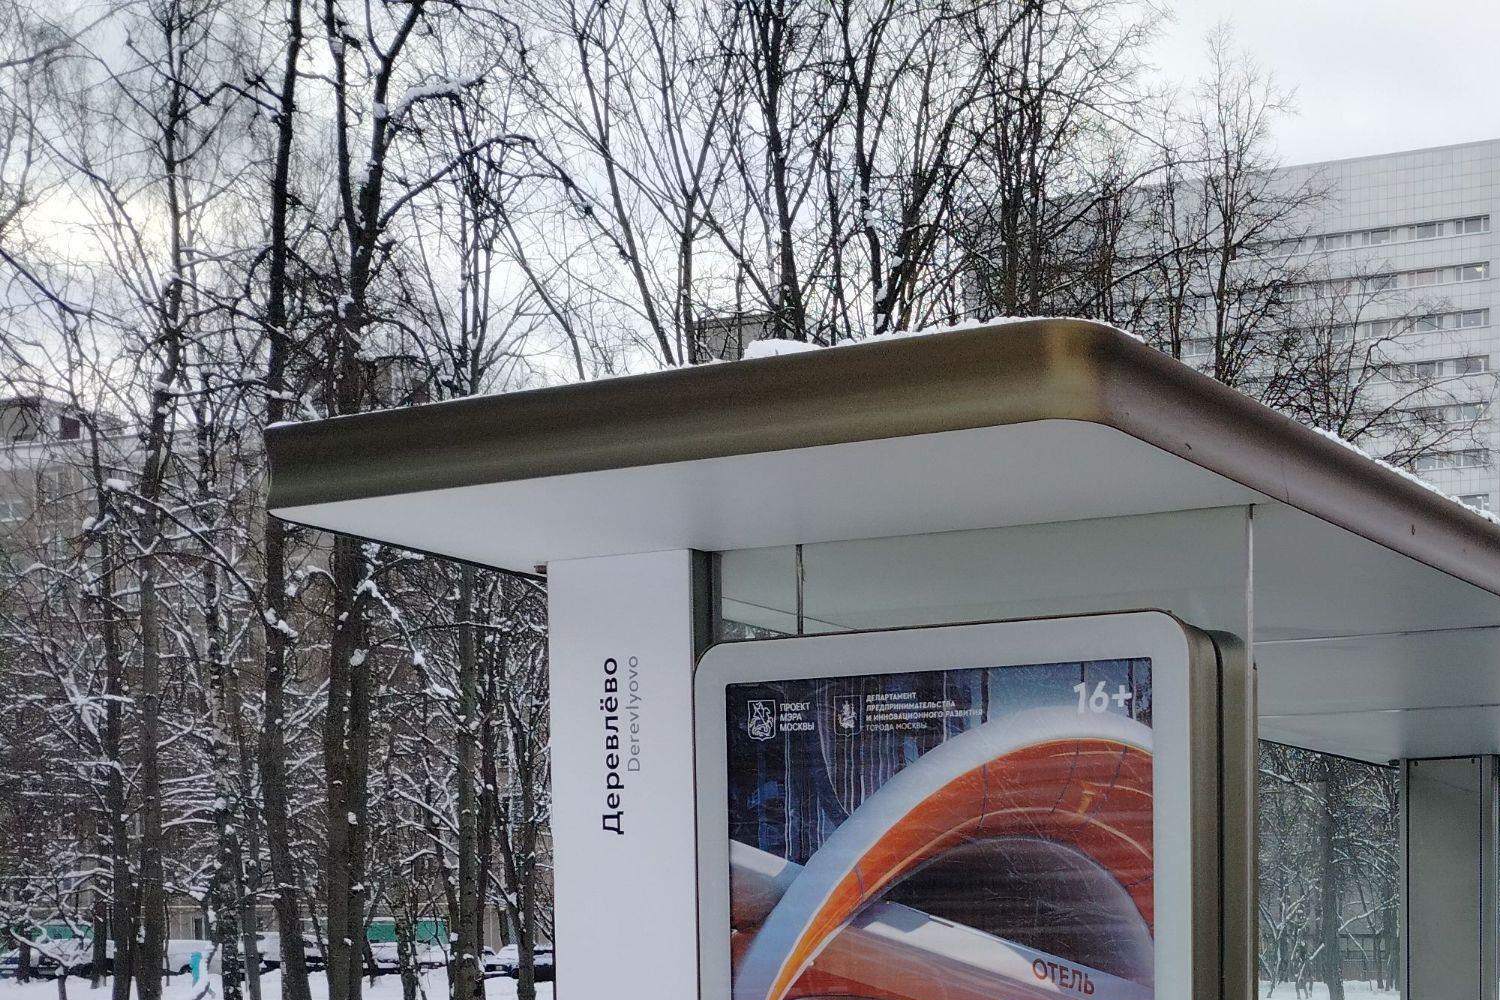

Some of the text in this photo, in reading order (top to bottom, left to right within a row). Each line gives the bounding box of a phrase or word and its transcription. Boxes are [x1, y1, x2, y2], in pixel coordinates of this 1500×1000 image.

[866, 692, 917, 702] ДЕПАРТАМЕНТ
[1073, 681, 1132, 713] 16+
[779, 702, 810, 712] ПРОЕКТ
[866, 701, 956, 711] ПРЕДПРИНИМАТЕЛЬСТВА
[626, 656, 641, 771] Derevlyovo
[779, 713, 802, 722] МЭРА
[873, 711, 943, 721] ИННОВАЦИОННОГО
[945, 709, 983, 717] РАЗВИТИЯ
[779, 722, 815, 731] МОСКВЫ
[896, 722, 927, 730] МОСКВЫ
[600, 657, 624, 834] Деревлёво
[1032, 958, 1095, 995] ОТЕЛЬ
